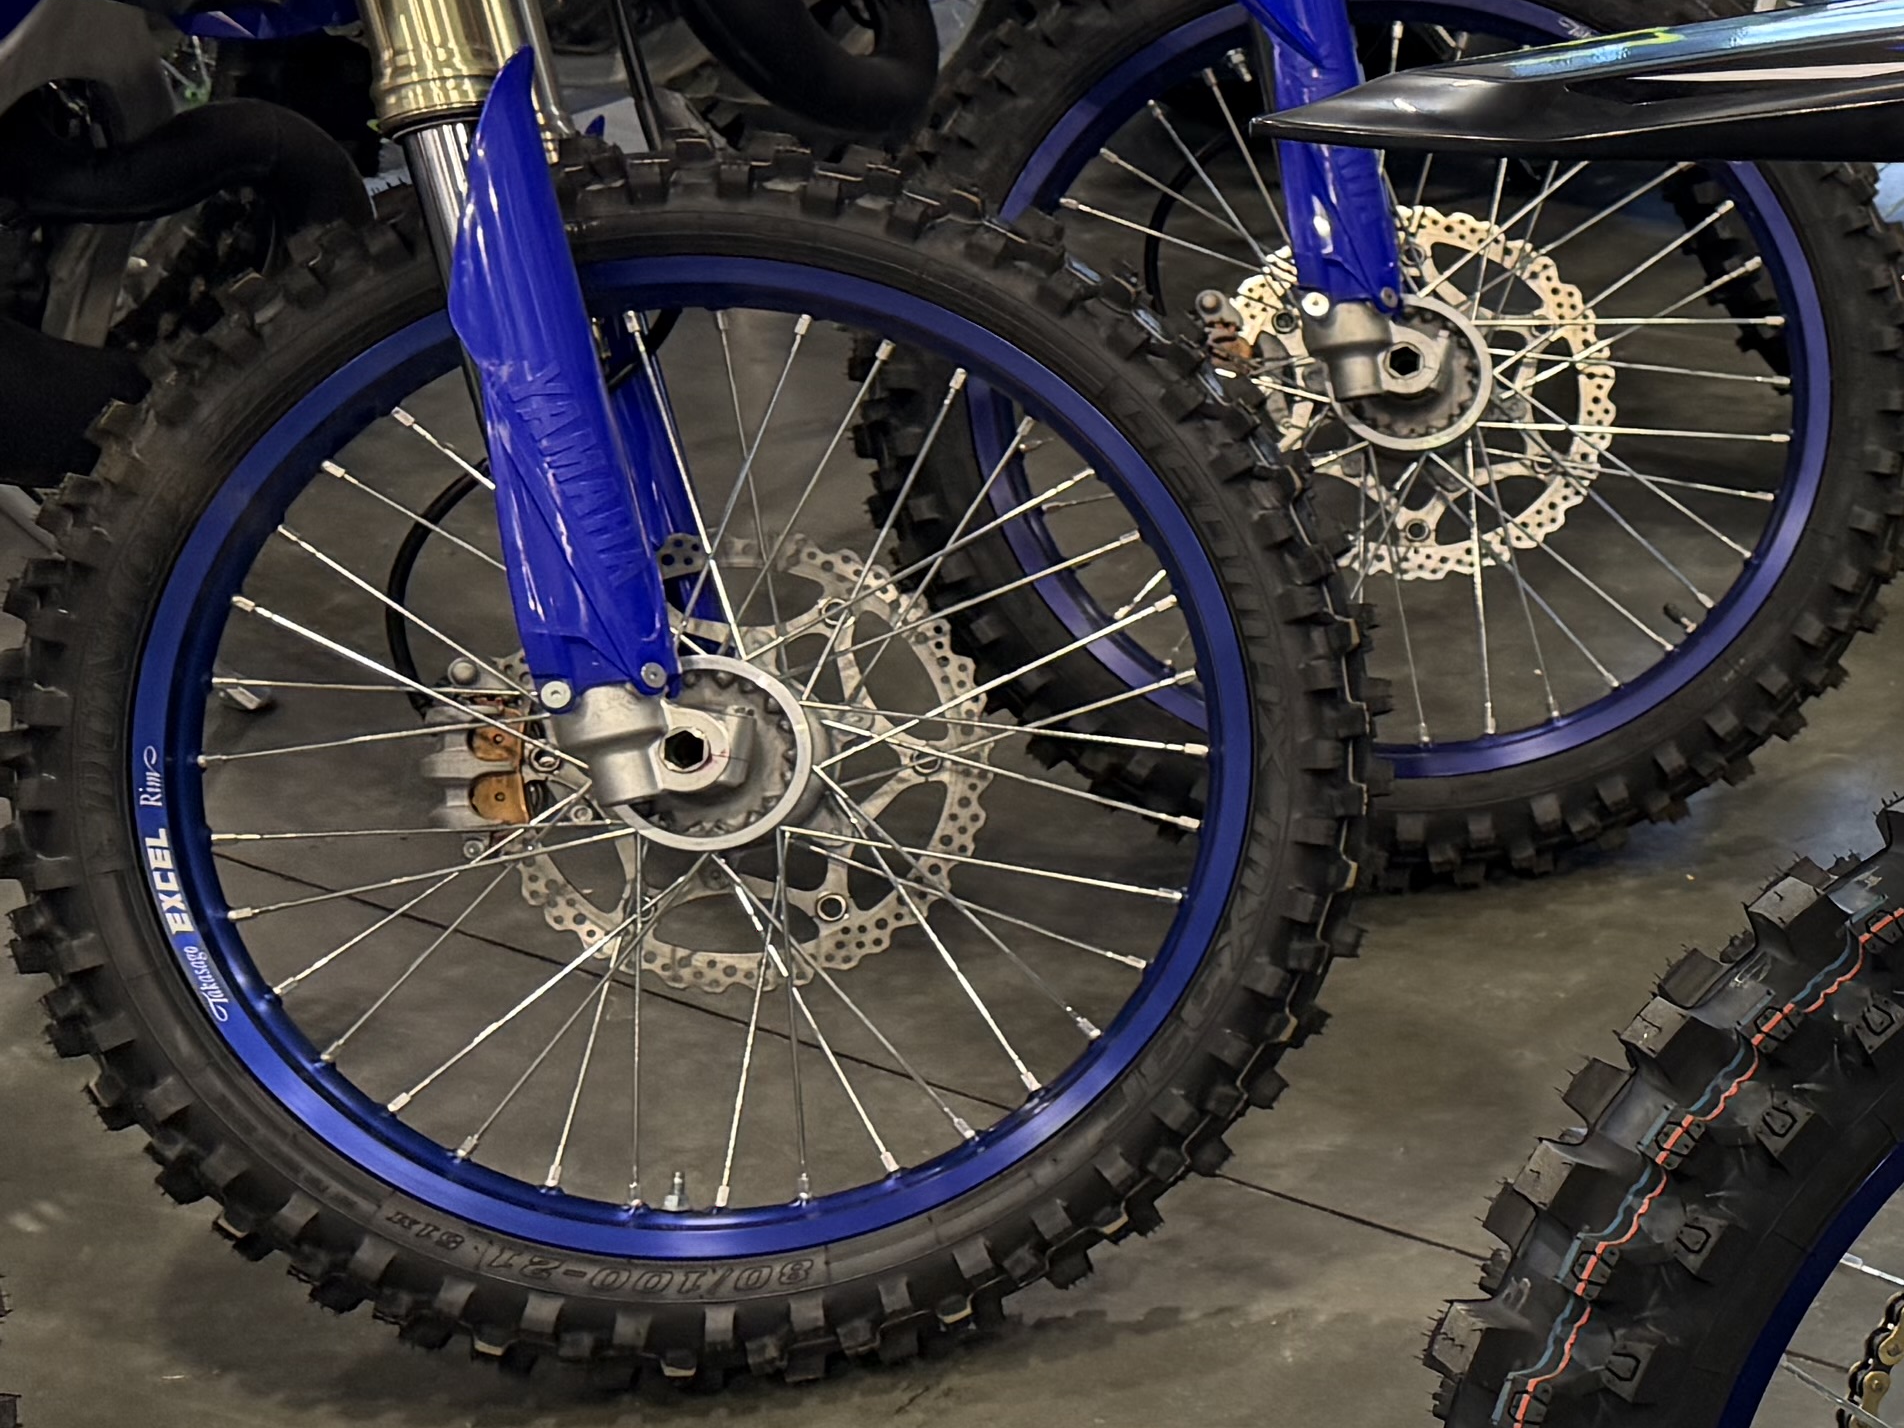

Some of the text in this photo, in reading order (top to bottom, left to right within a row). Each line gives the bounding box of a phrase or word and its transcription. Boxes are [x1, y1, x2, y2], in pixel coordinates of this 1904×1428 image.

[138, 744, 229, 1022] Takasago EXCEL Rim
[487, 1244, 816, 1298] 80/100-21
